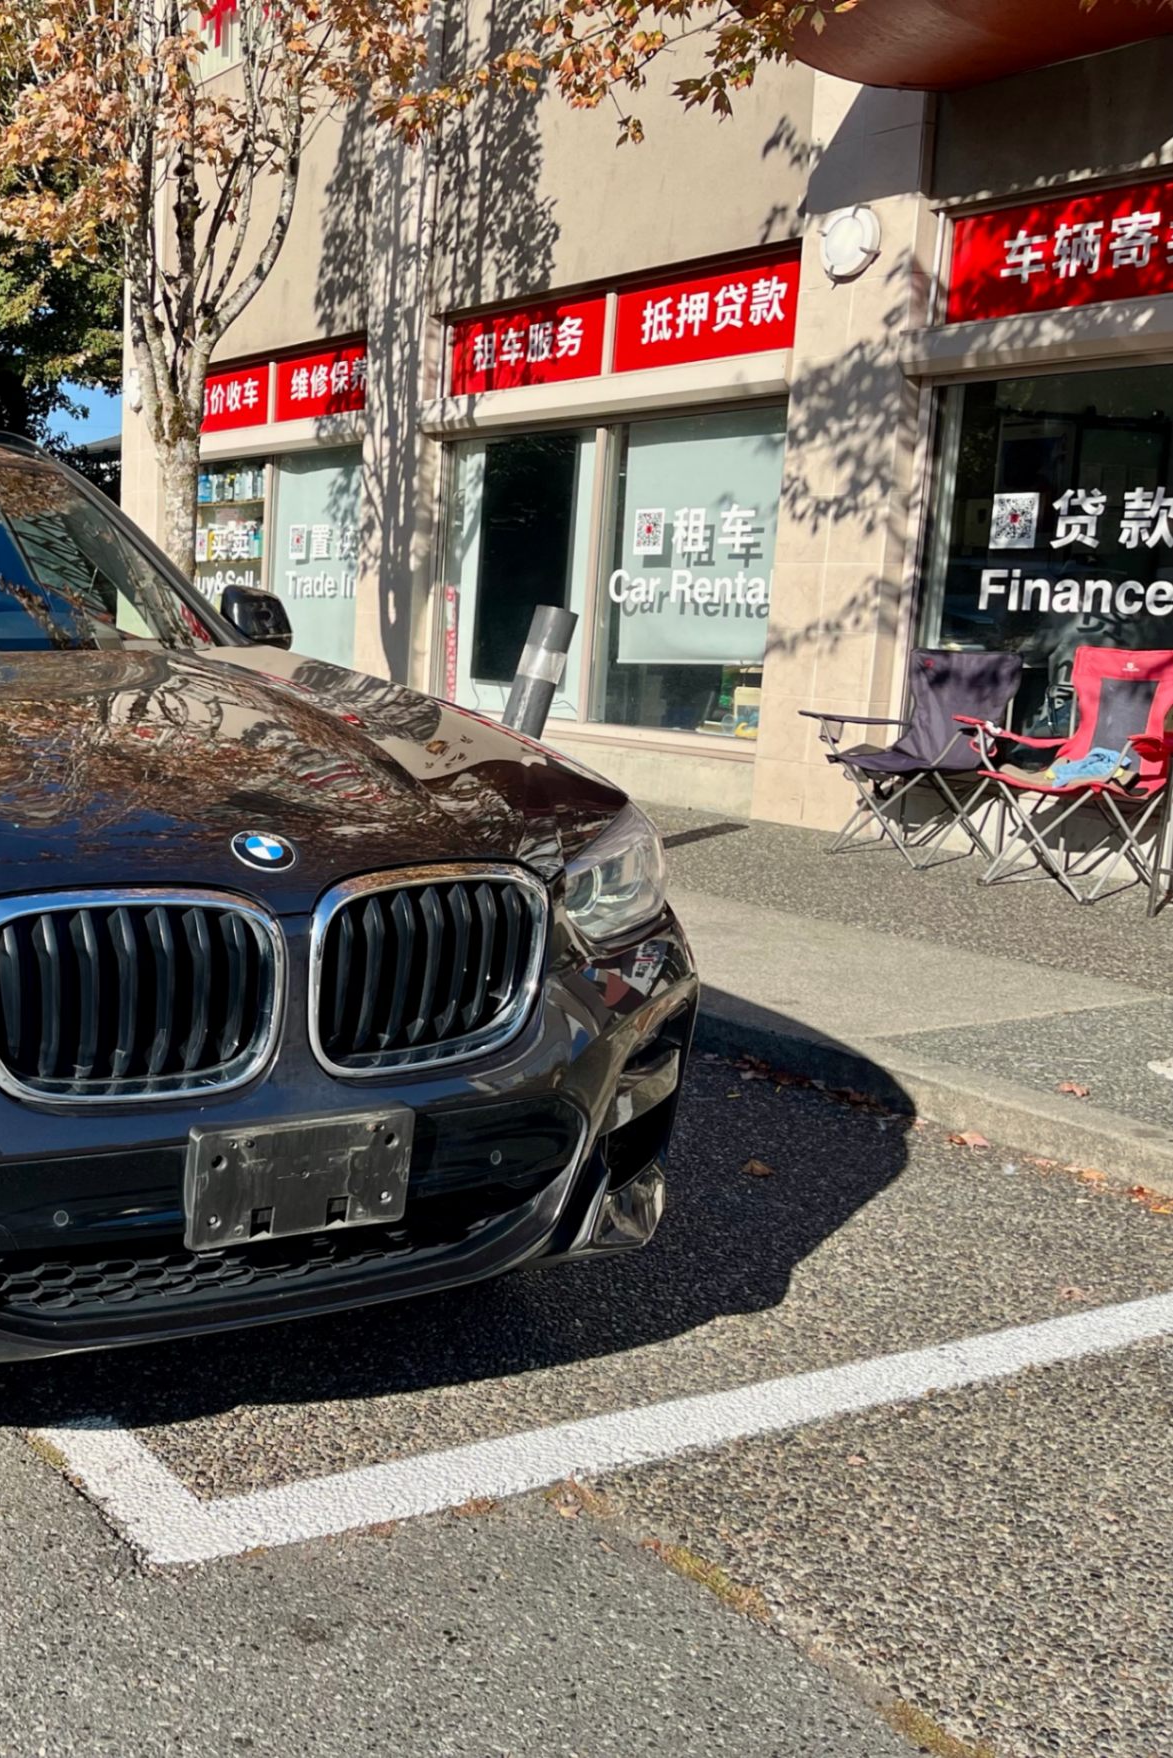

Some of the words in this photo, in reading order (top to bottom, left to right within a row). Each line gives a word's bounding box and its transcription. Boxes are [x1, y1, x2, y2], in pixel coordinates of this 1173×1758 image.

[999, 210, 1173, 284] 车辆寄
[641, 276, 788, 345] 抵押贷款
[473, 315, 585, 373] 租车服务
[204, 378, 259, 416] 价收车
[210, 524, 250, 560] 买卖
[671, 503, 756, 554] 租车
[1049, 486, 1173, 549] 贷款
[194, 569, 254, 602] uy&Sell
[285, 570, 336, 597] Trade
[608, 568, 661, 604] Car
[977, 568, 1173, 617] Finance
